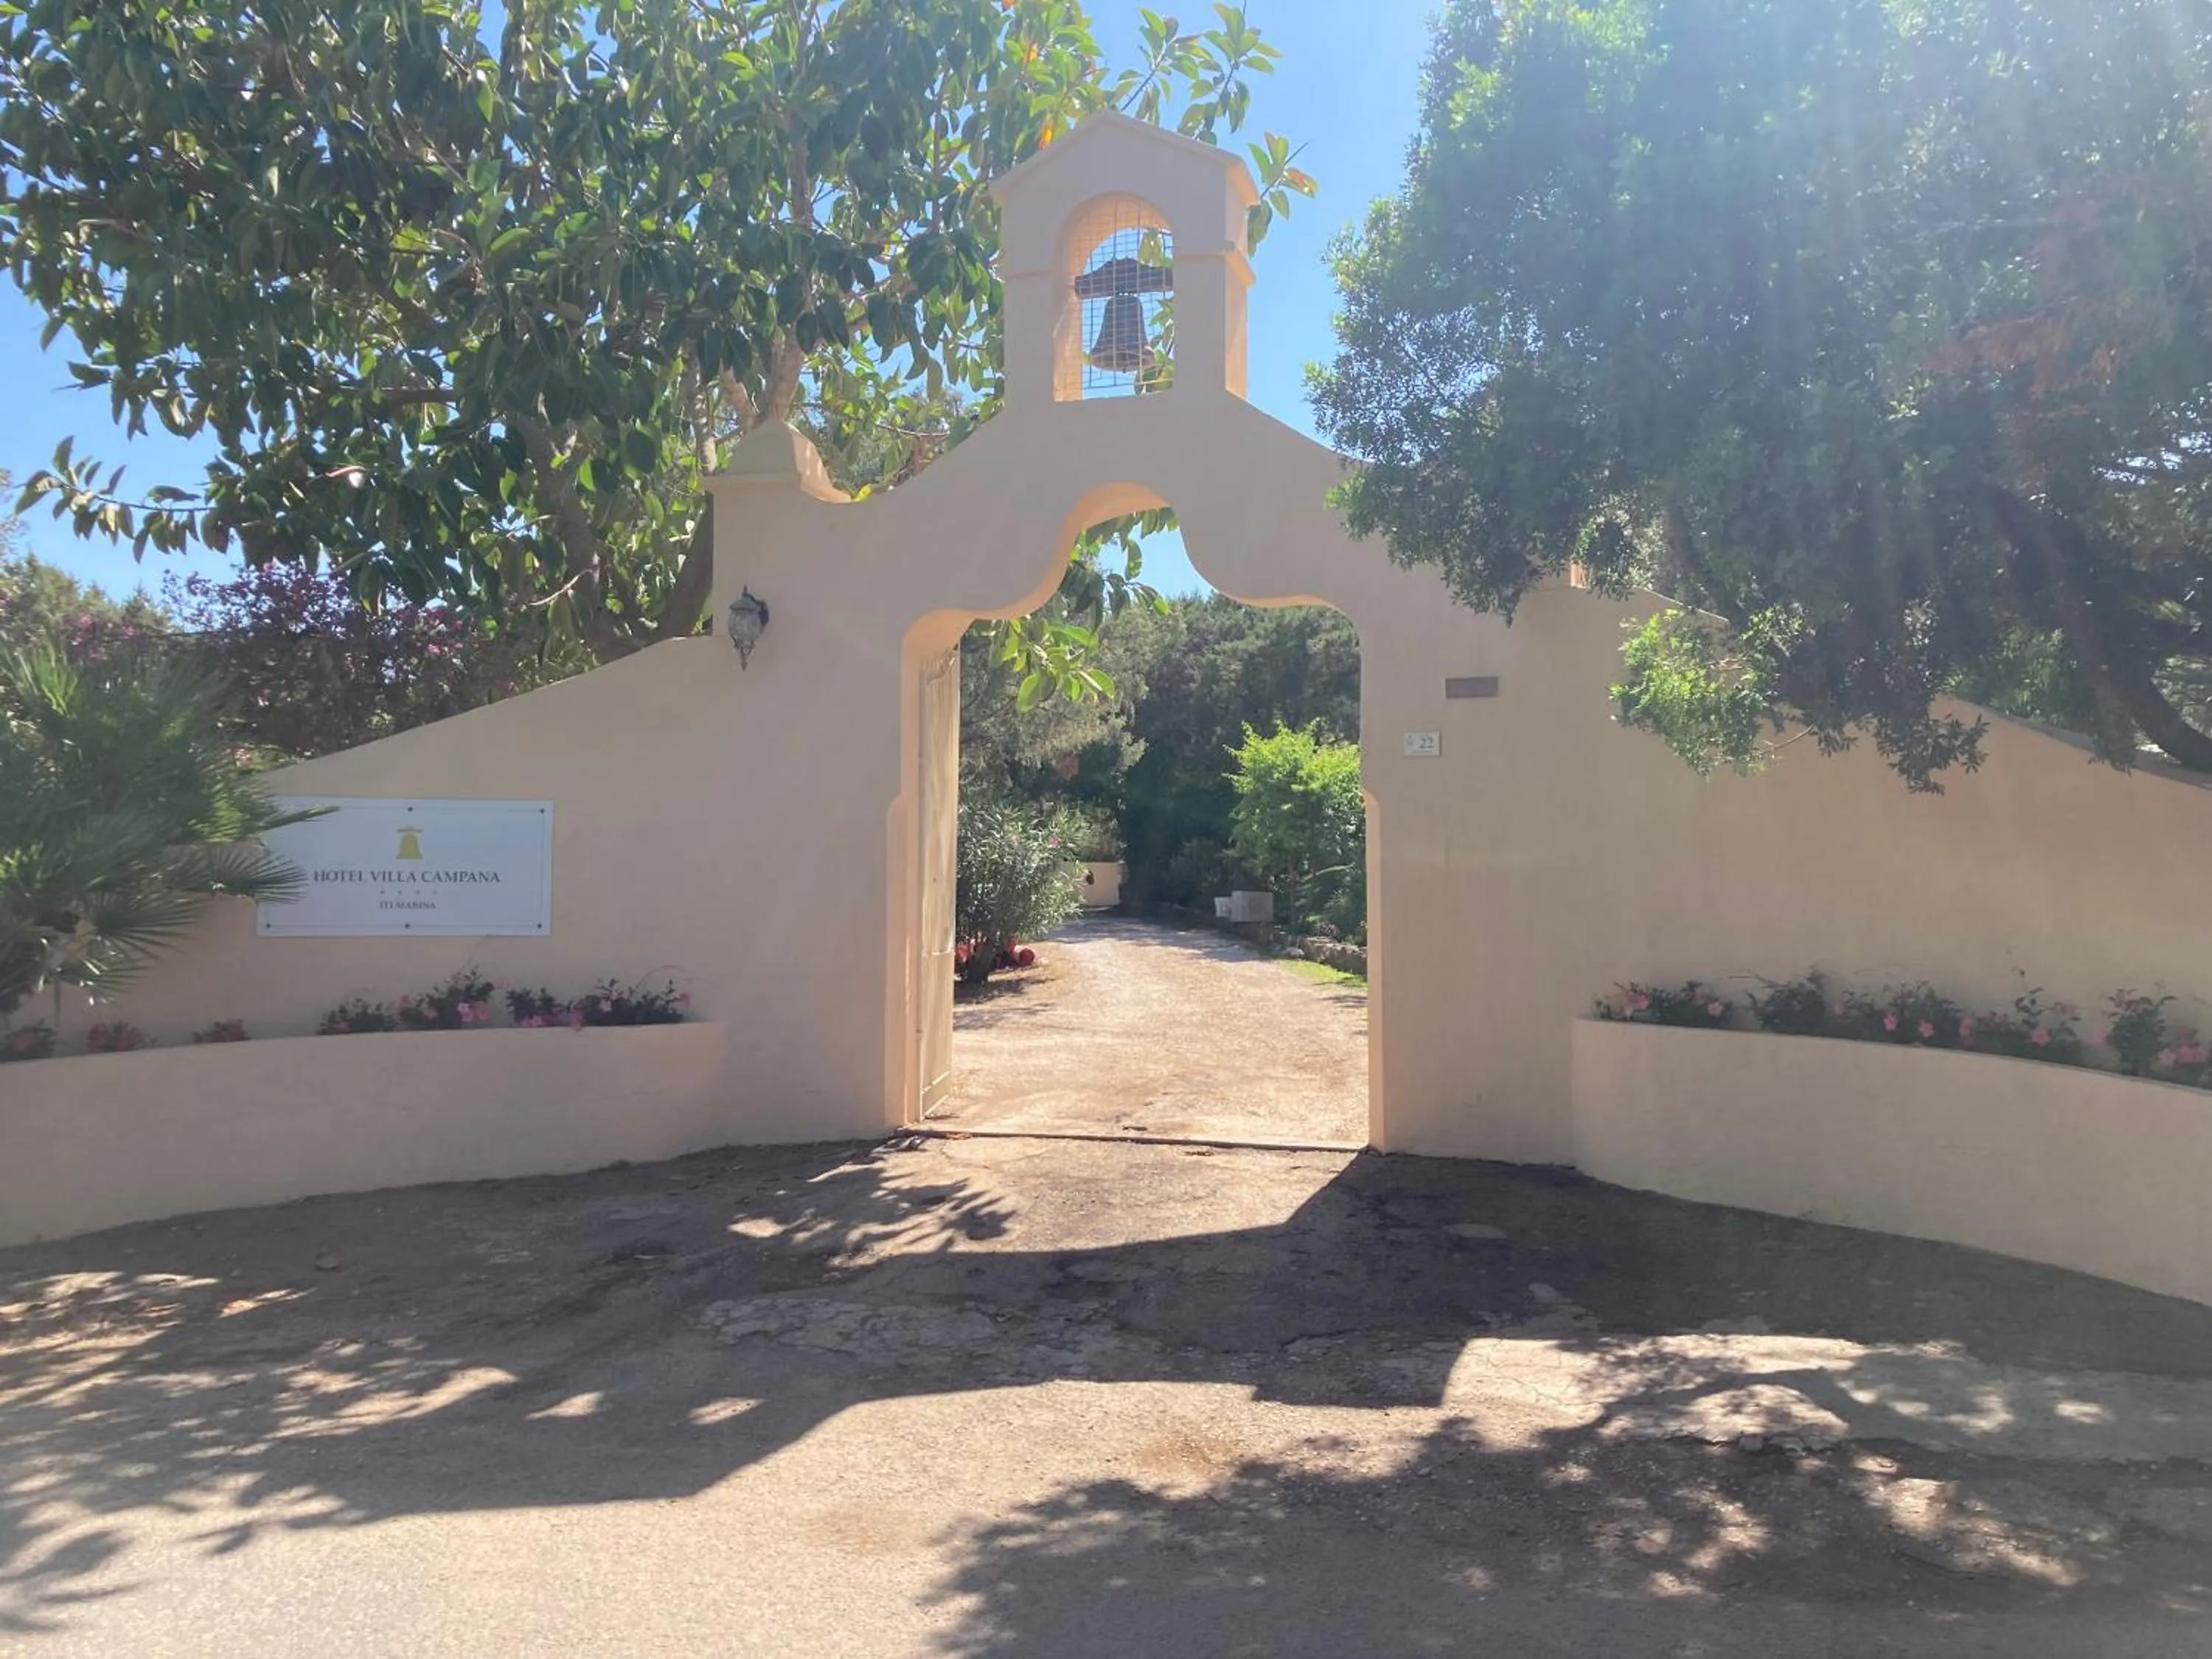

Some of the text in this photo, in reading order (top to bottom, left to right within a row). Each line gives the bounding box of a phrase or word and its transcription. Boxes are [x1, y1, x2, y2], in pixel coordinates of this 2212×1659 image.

[1419, 737, 1434, 749] 22
[313, 870, 501, 883] HOTEL VILLA CAMPANA
[396, 901, 437, 910] MARINA
